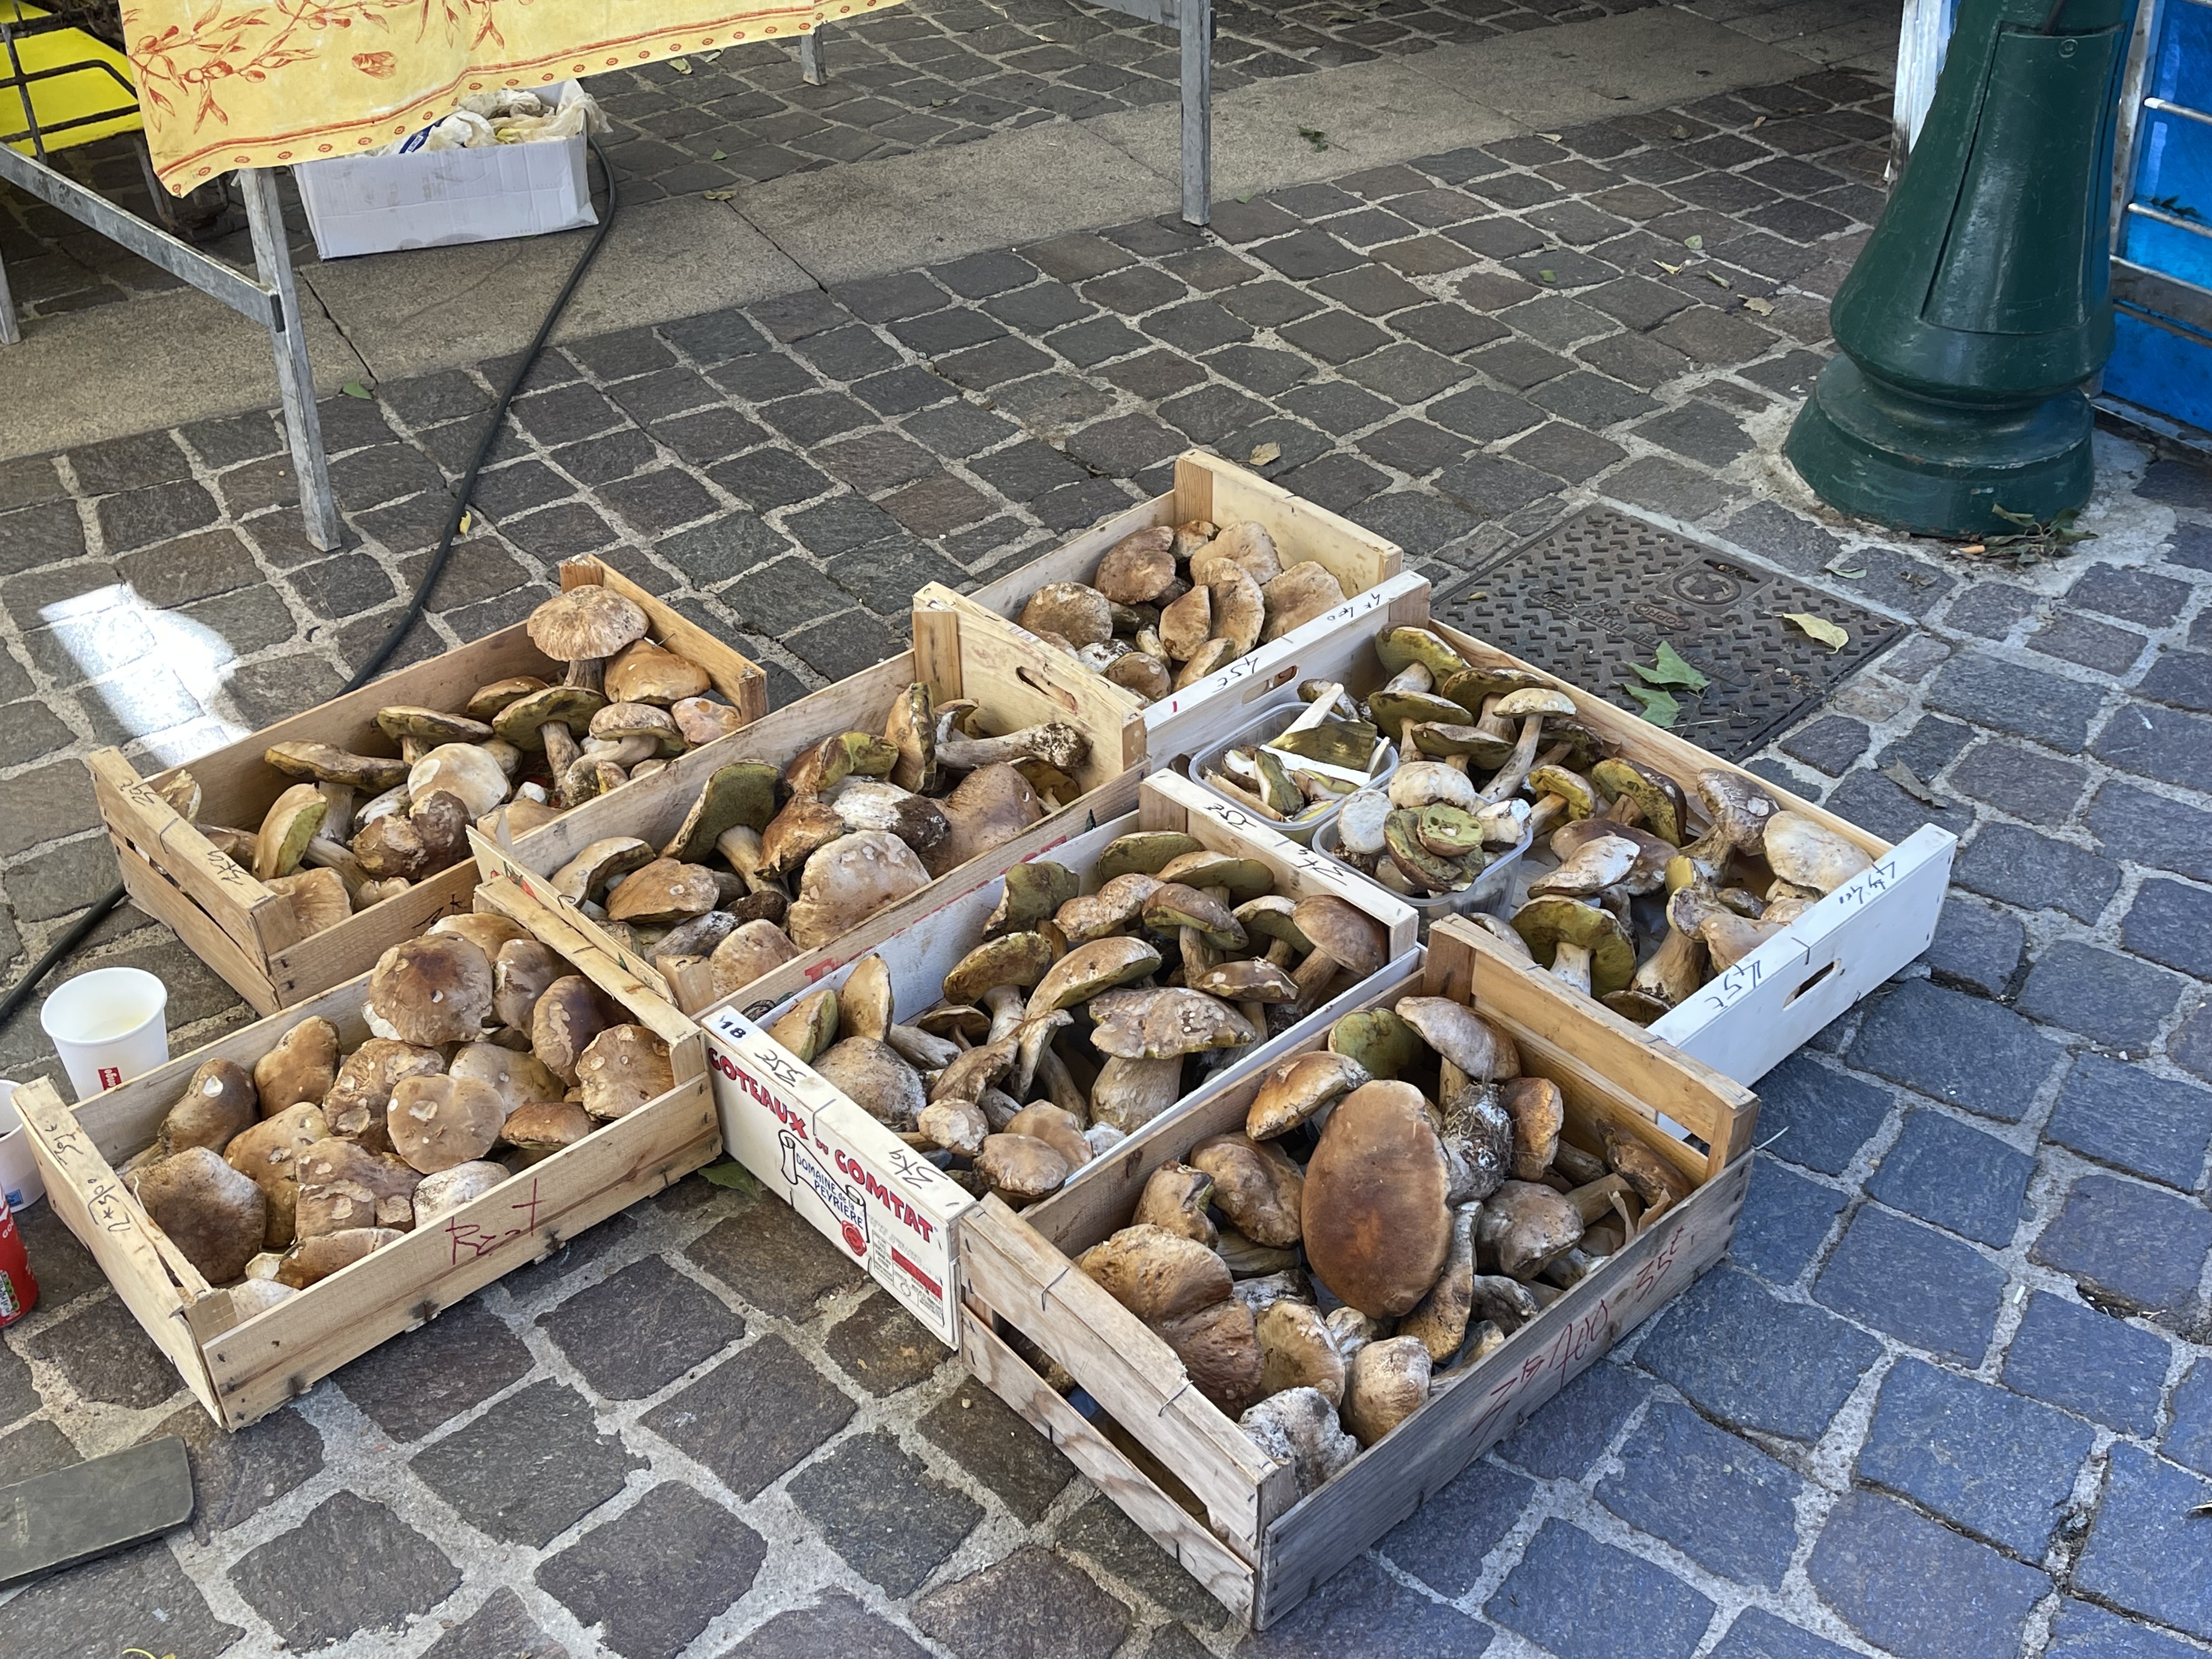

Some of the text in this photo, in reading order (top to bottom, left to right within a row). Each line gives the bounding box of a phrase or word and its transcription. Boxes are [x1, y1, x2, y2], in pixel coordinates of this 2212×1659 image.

[720, 1020, 747, 1039] 18
[708, 1047, 933, 1244] COTEAUX DU COMTAT
[796, 1152, 855, 1211] DOMAINE de la
[814, 1180, 865, 1231] PEYRIERE
